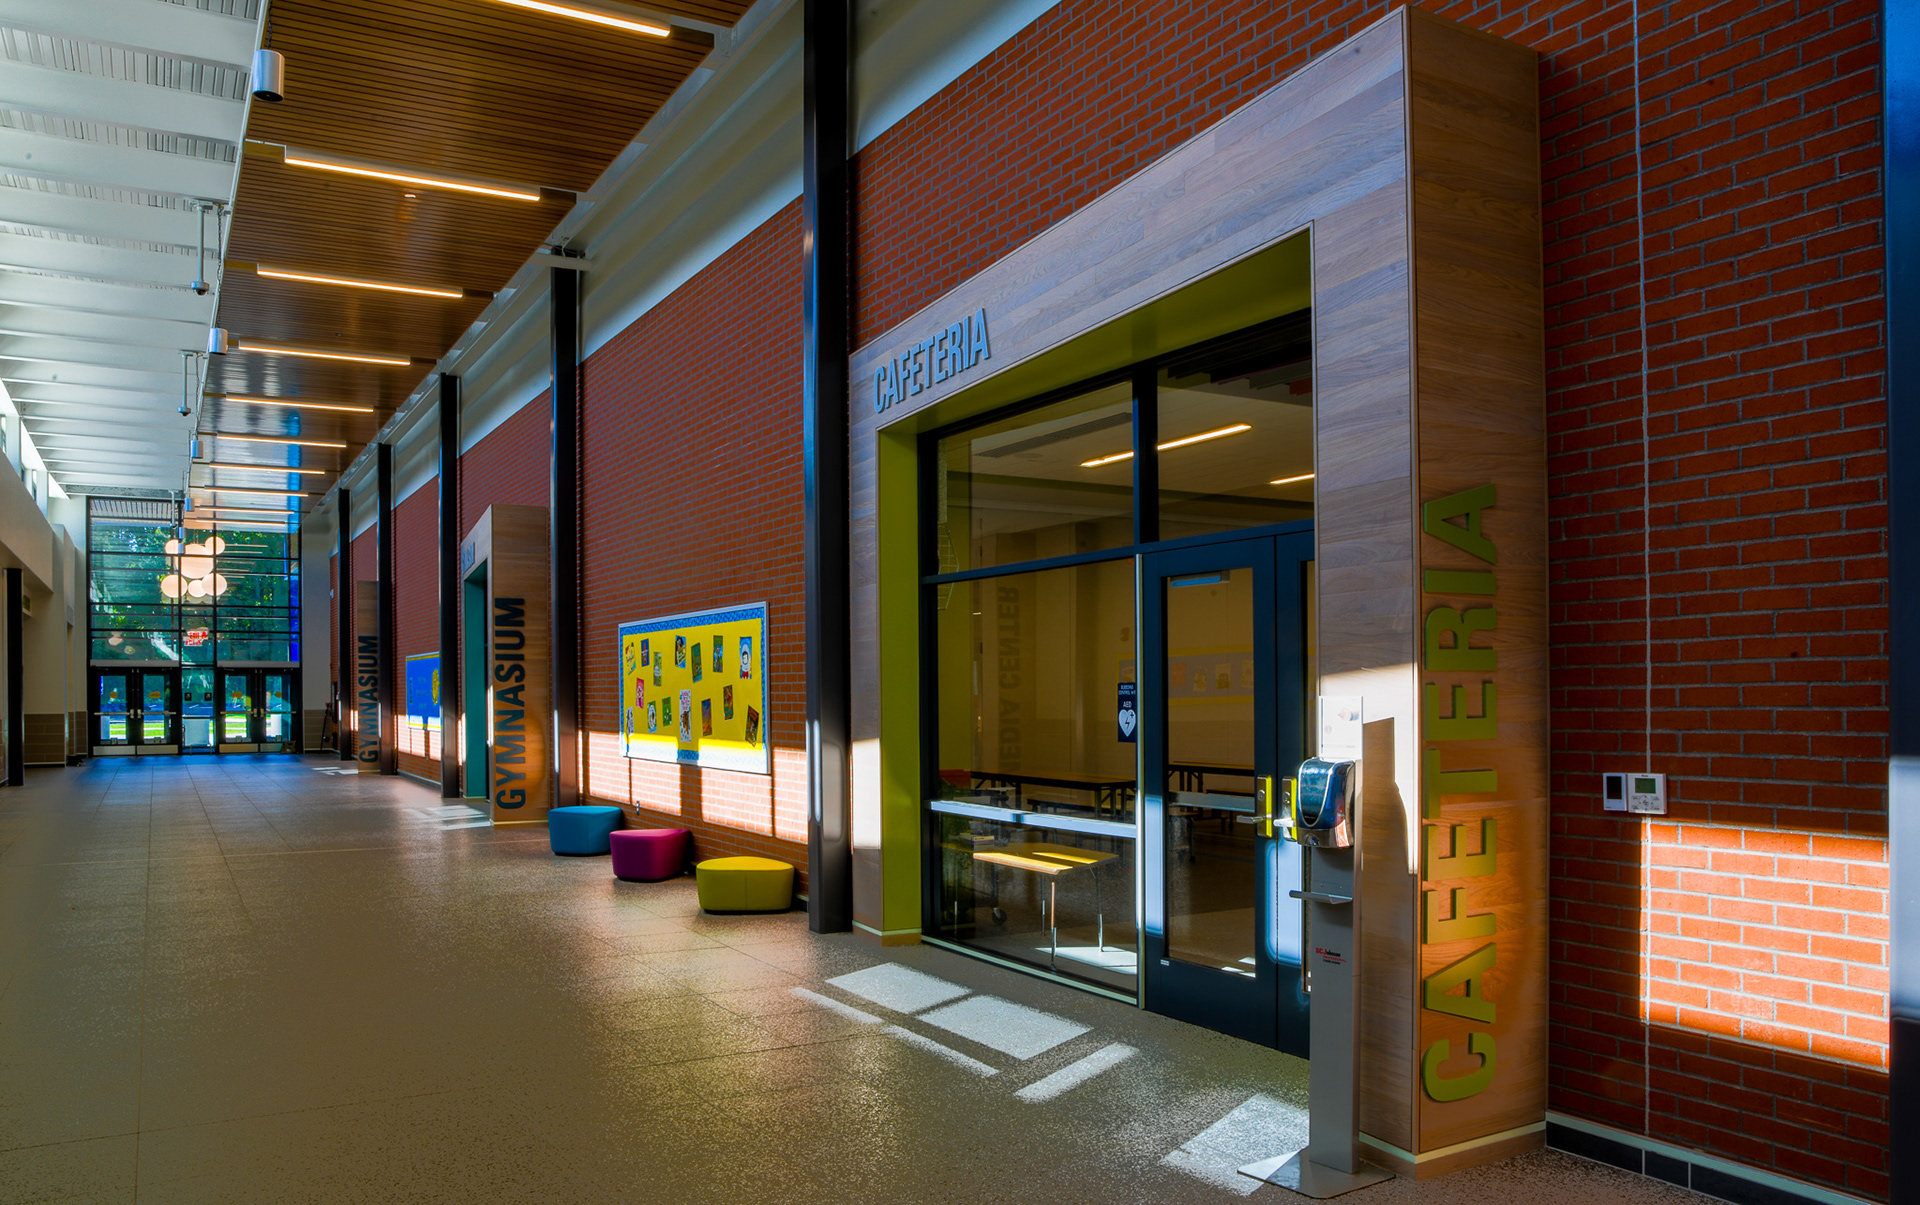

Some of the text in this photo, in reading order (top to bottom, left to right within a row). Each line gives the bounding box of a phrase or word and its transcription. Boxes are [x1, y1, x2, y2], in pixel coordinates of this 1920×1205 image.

[873, 308, 991, 413] CAFETERIA
[358, 635, 379, 763] GYMNASIUM
[494, 597, 525, 810] GYMNASIUM
[1422, 483, 1498, 1103] CAFETERIA
